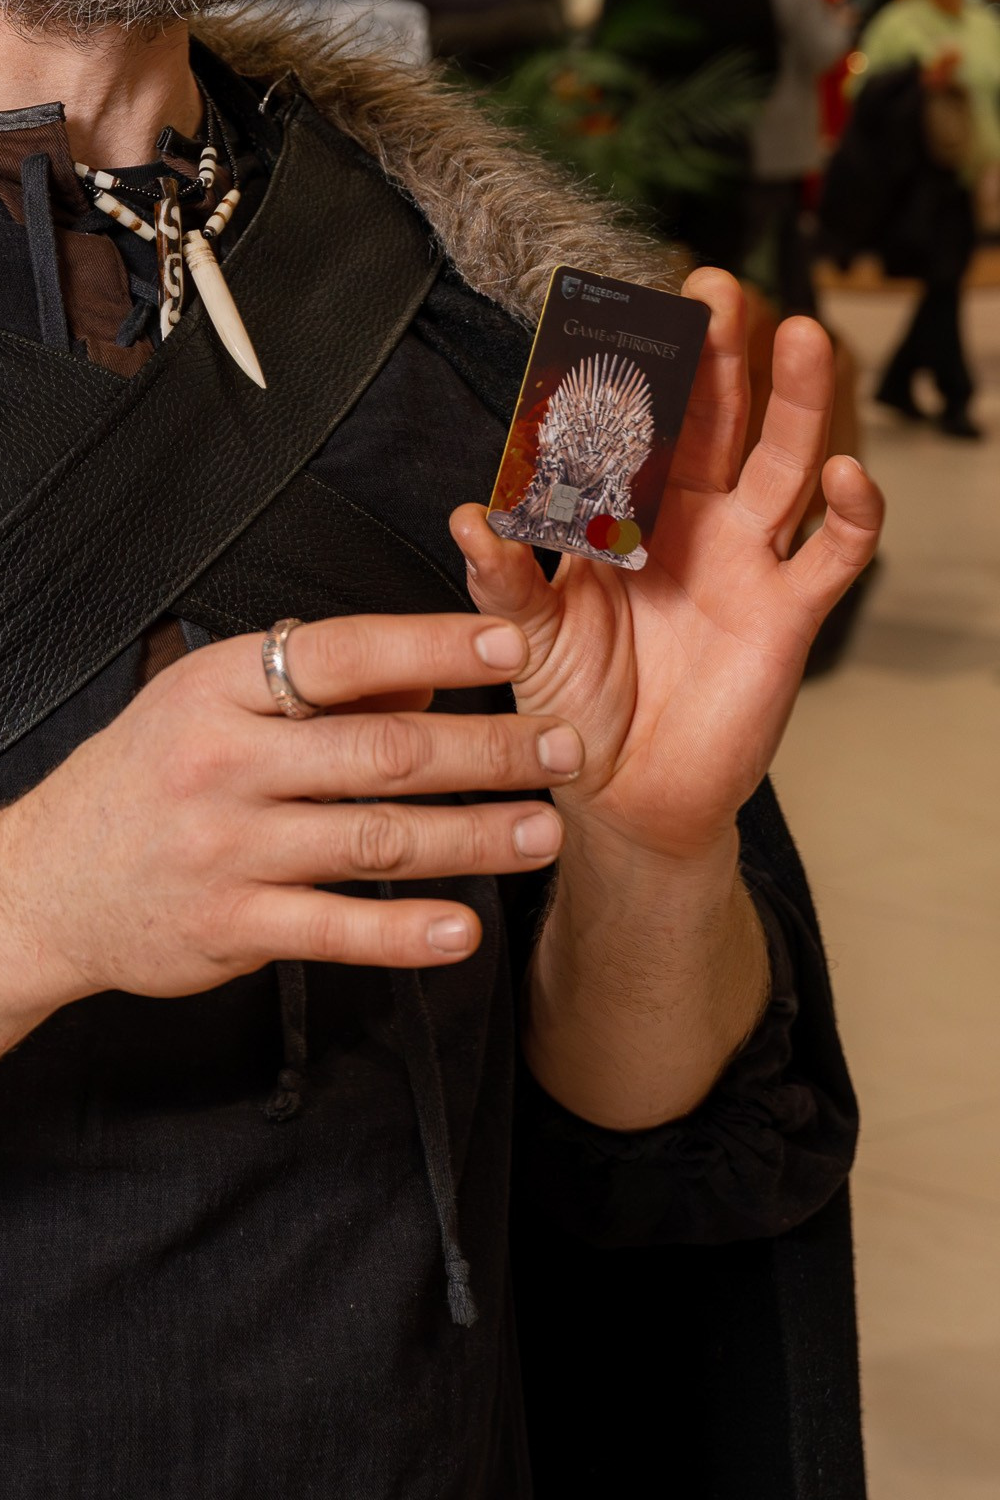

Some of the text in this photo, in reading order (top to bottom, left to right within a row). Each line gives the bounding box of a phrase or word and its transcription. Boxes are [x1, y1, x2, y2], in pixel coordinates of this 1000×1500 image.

[581, 293, 601, 304] BANK
[583, 284, 630, 303] FREEDOM
[564, 319, 607, 341] GAME
[616, 330, 680, 359] THRONES
